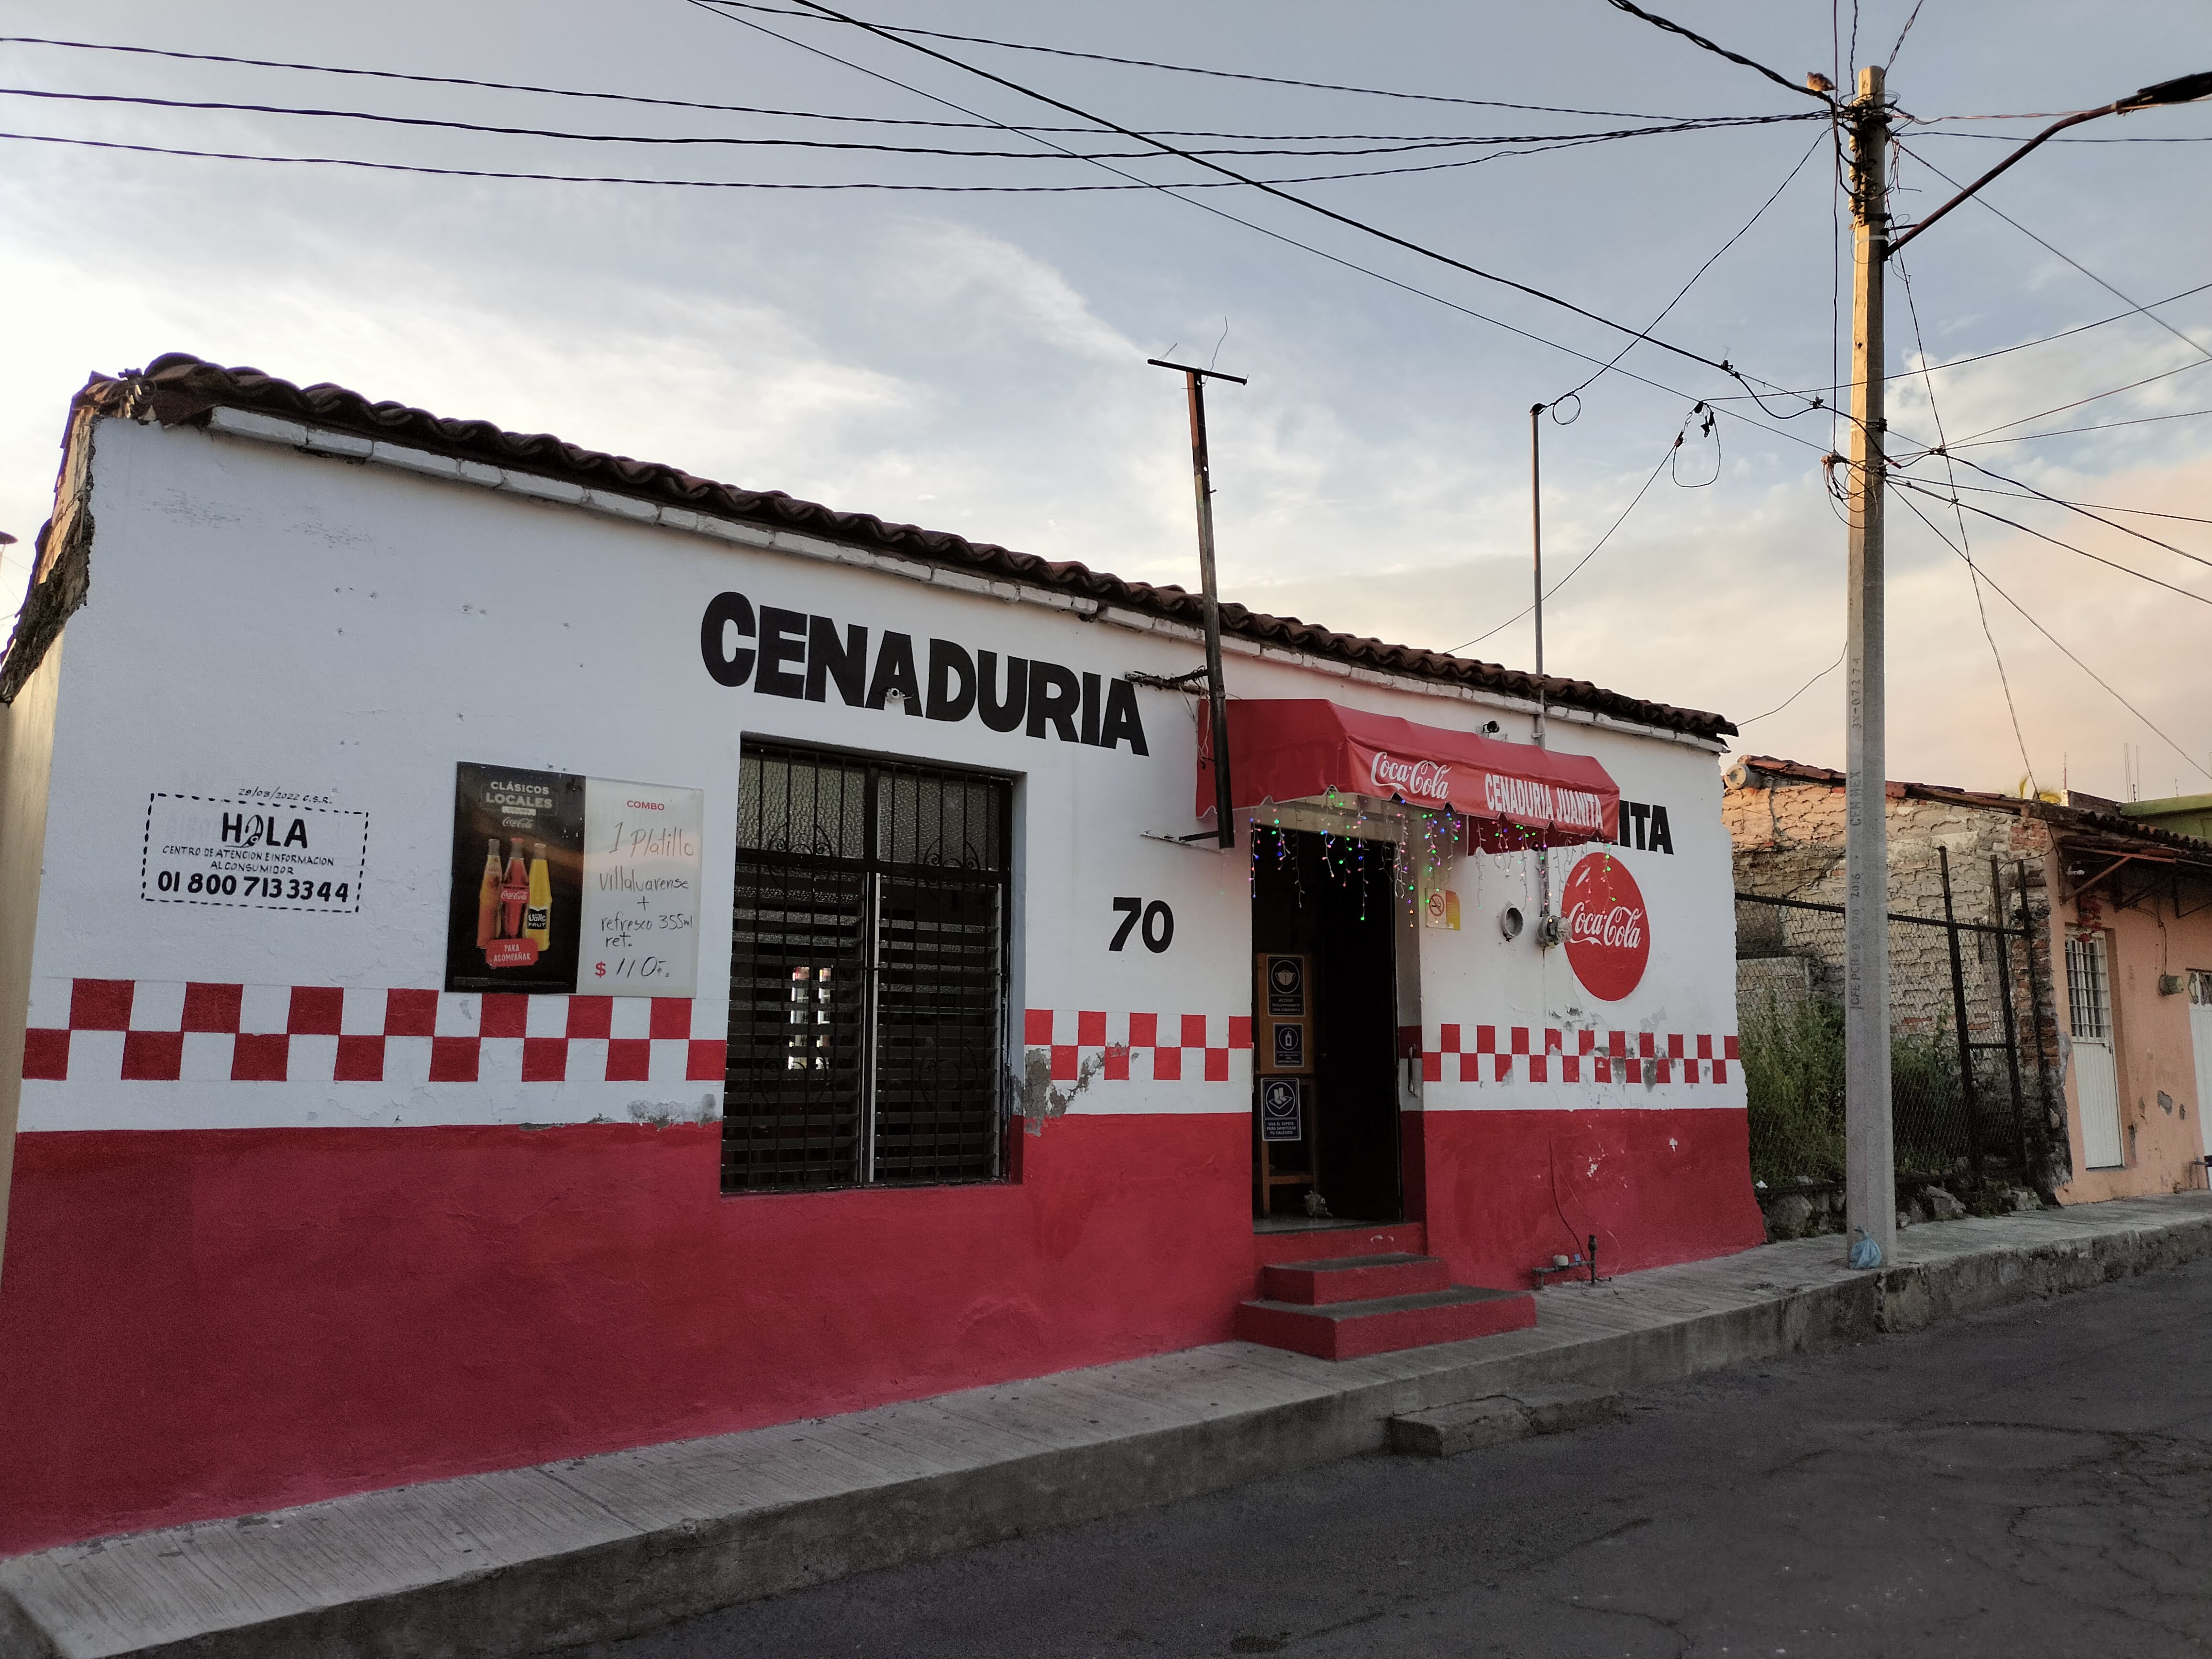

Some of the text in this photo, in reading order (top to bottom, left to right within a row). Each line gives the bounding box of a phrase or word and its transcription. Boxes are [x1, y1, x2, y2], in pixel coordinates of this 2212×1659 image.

[701, 591, 1149, 756] CENADURIA
[1370, 751, 1452, 800] Coca-Cola
[491, 781, 549, 795] CLÁSICOS
[486, 792, 553, 808] LOCALES
[627, 800, 665, 811] COMBO
[1485, 773, 1603, 829] CENADURIA JUANITA
[609, 821, 624, 854] 1
[1614, 800, 1674, 855] ITA
[163, 845, 334, 866] CENTRO DE ATENCION E INFORMACION
[210, 861, 294, 875] AL CONSUMIDOR
[158, 871, 180, 892] 01
[188, 873, 237, 896] 800
[1109, 897, 1174, 953] 70
[504, 944, 520, 952] PARA
[606, 931, 632, 948] ret.
[494, 952, 531, 962] ACOMPAÑAR
